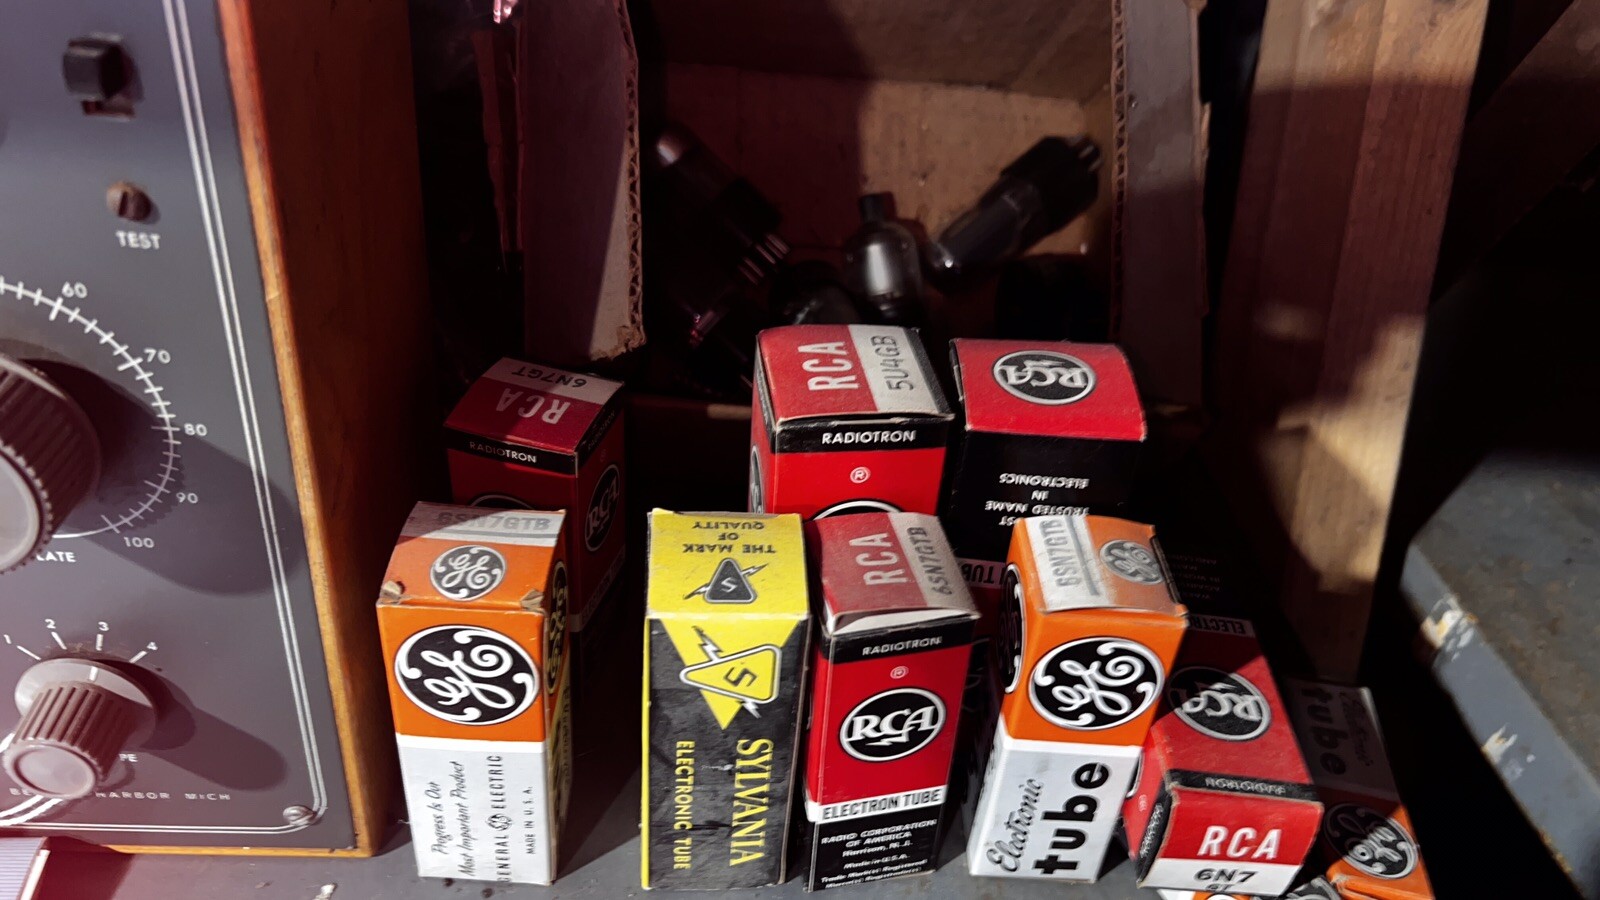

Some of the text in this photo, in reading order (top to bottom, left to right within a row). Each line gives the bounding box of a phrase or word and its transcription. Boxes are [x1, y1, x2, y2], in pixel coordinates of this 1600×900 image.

[115, 230, 161, 249] TEST
[61, 282, 88, 299] 60
[144, 348, 171, 364] 70
[798, 341, 859, 391] RCA
[871, 335, 914, 391] 5U4GB
[511, 366, 587, 388] 6N7GT
[1000, 363, 1090, 389] RCA
[495, 387, 571, 425] RCA
[183, 423, 208, 436] 80
[821, 430, 917, 445] RADIOTRON
[469, 441, 538, 463] RADIOTRON
[999, 472, 1090, 490] ELECTRONICS
[176, 492, 199, 504] 90
[1031, 490, 1050, 501] IN
[587, 475, 619, 540] RCA
[985, 500, 1028, 514] NAME
[438, 512, 551, 531] 6SN7GTB
[692, 521, 765, 530] QUALITY
[999, 516, 1018, 527] ST
[123, 536, 155, 548] 100
[718, 532, 740, 541] OF
[36, 551, 77, 563] LATE
[683, 543, 777, 553] THE MARK
[848, 532, 909, 586] RCA
[906, 526, 953, 596] 6SN7GTB
[960, 563, 996, 584] TUB
[720, 576, 738, 593] S
[44, 618, 56, 629] 2
[98, 621, 109, 632] 3
[1188, 615, 1247, 635] ELECTR
[3, 634, 12, 644] 1
[146, 641, 158, 651] 4
[862, 636, 944, 656] RADIOTRON
[723, 666, 758, 688] S
[1182, 690, 1263, 722] RCA
[846, 705, 938, 745] RCA
[1301, 687, 1348, 775] tube
[119, 753, 138, 763] PE
[95, 791, 231, 801] HARBOR MICH
[672, 740, 696, 870] ELECTRONIC TUBE
[729, 738, 774, 867] SYLVANIA
[822, 789, 941, 820] ELECTRON TUBE
[425, 781, 452, 855] Progress Is Our
[449, 761, 477, 877] Most Important Product
[486, 755, 513, 883] GENERAL ELECTRIC
[523, 820, 534, 829] IN
[986, 778, 1044, 873] Electronic
[1031, 762, 1112, 875] tube
[821, 819, 938, 845] RADIO CORPORATION
[845, 831, 913, 848] OF AMERICA
[525, 834, 536, 855] MADE
[1196, 825, 1283, 861] RCA
[1193, 867, 1259, 884] 6N7
